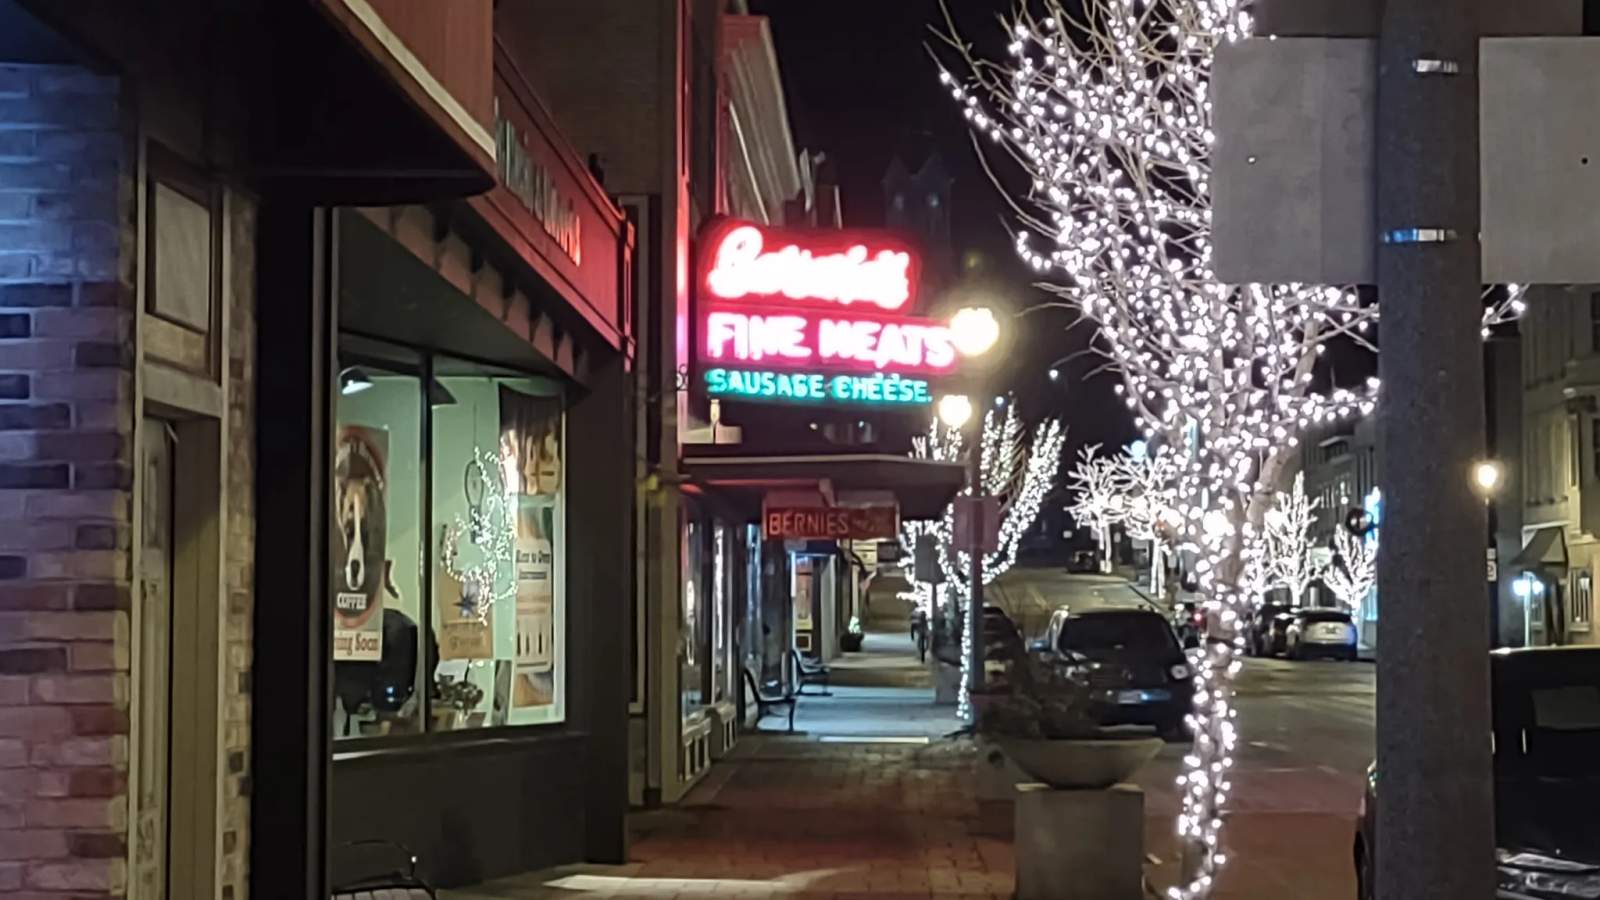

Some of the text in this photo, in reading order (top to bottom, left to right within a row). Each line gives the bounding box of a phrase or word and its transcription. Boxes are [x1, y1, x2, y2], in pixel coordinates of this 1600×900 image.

[707, 312, 955, 368] FINE MEATS
[705, 368, 825, 399] SAUSAGE
